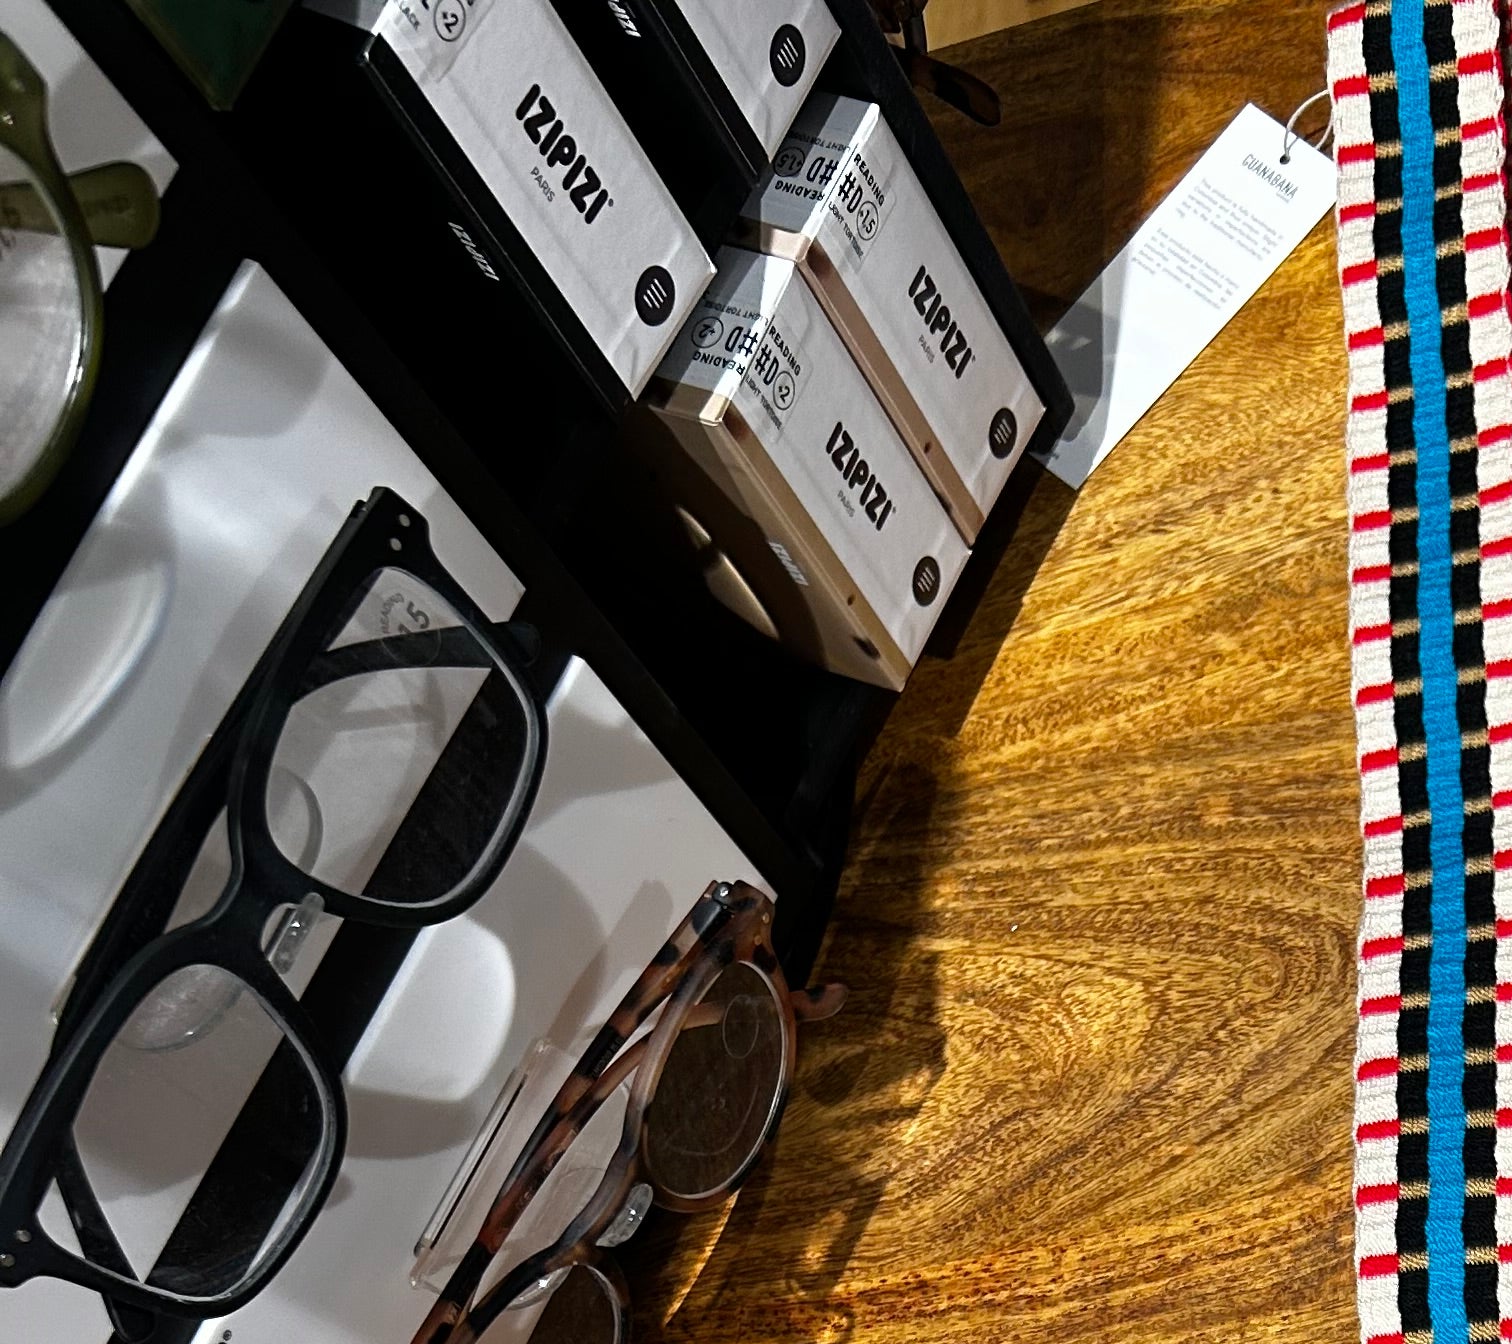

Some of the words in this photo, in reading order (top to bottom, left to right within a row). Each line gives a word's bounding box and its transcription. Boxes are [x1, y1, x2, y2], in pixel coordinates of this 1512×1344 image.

[530, 166, 556, 202] PARIS
[774, 180, 825, 201] READING
[853, 153, 885, 207] READING
[692, 350, 746, 376] READING
[769, 325, 801, 377] READING
